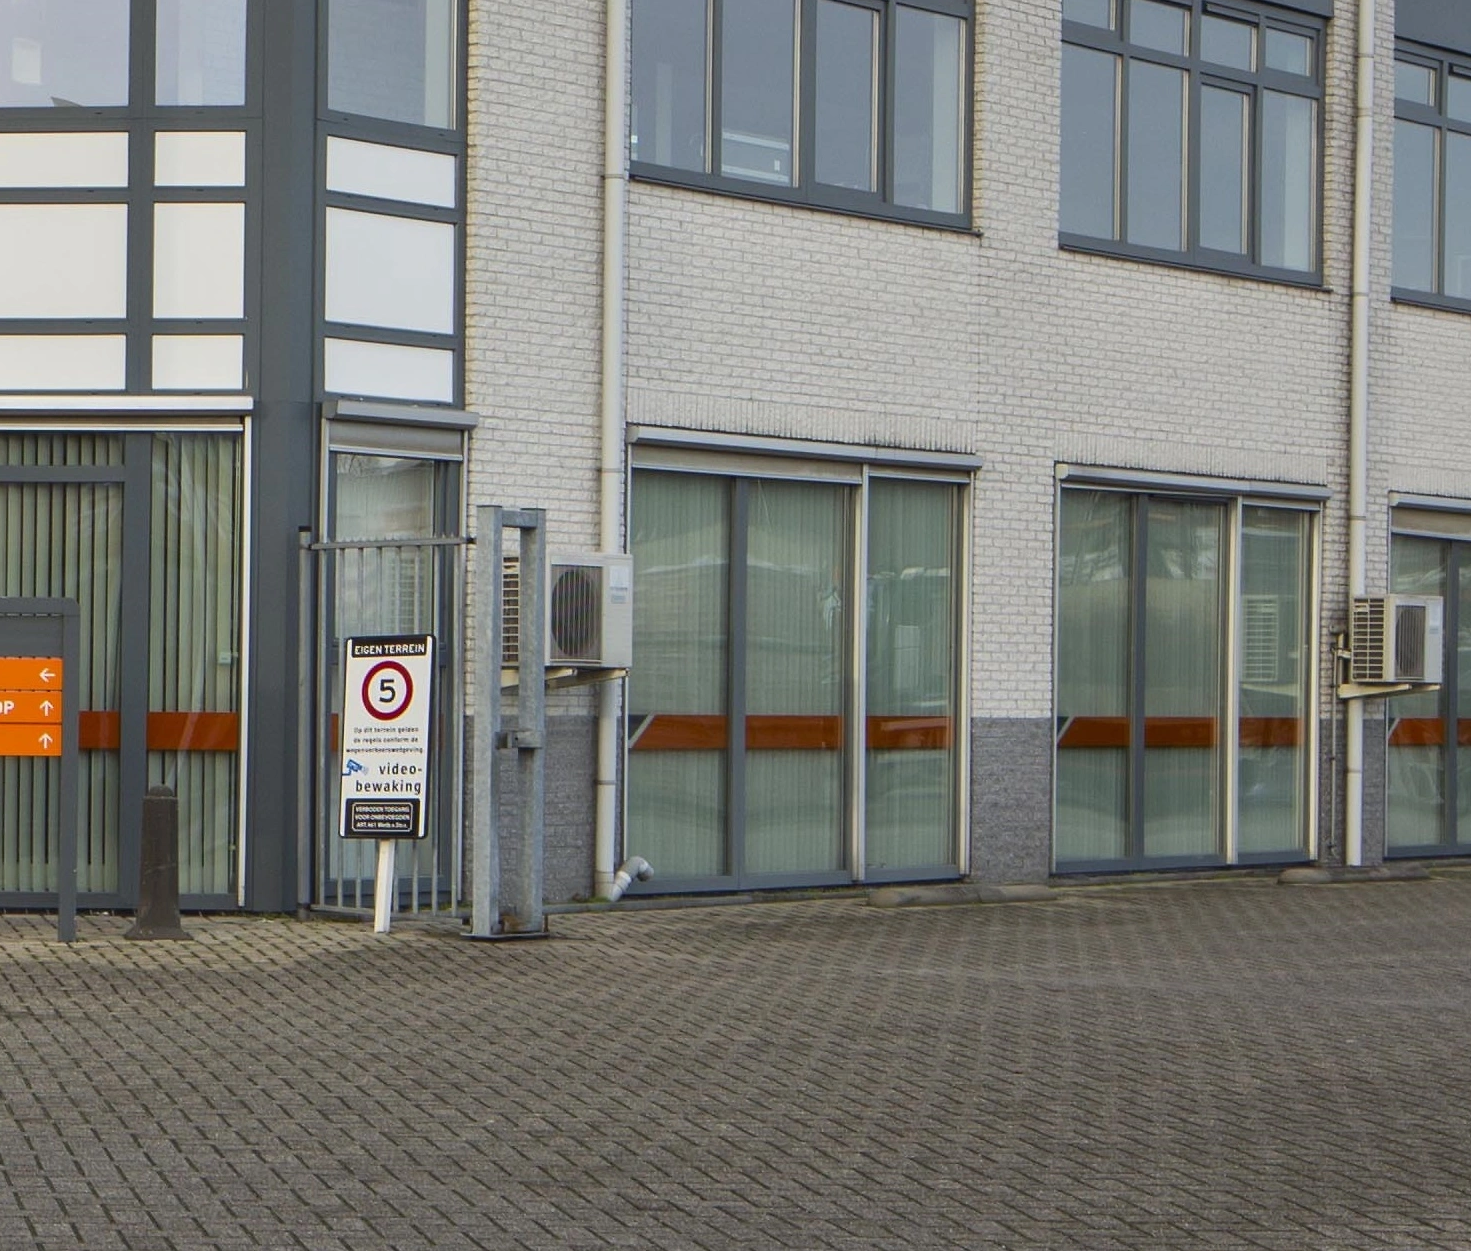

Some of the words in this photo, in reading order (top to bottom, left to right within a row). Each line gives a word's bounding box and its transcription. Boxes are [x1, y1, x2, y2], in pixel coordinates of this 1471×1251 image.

[355, 645, 382, 655] EIGEN
[384, 644, 425, 653] TERREIN
[379, 679, 396, 703] 5
[379, 763, 423, 775] video-
[356, 780, 421, 795] bewaking
